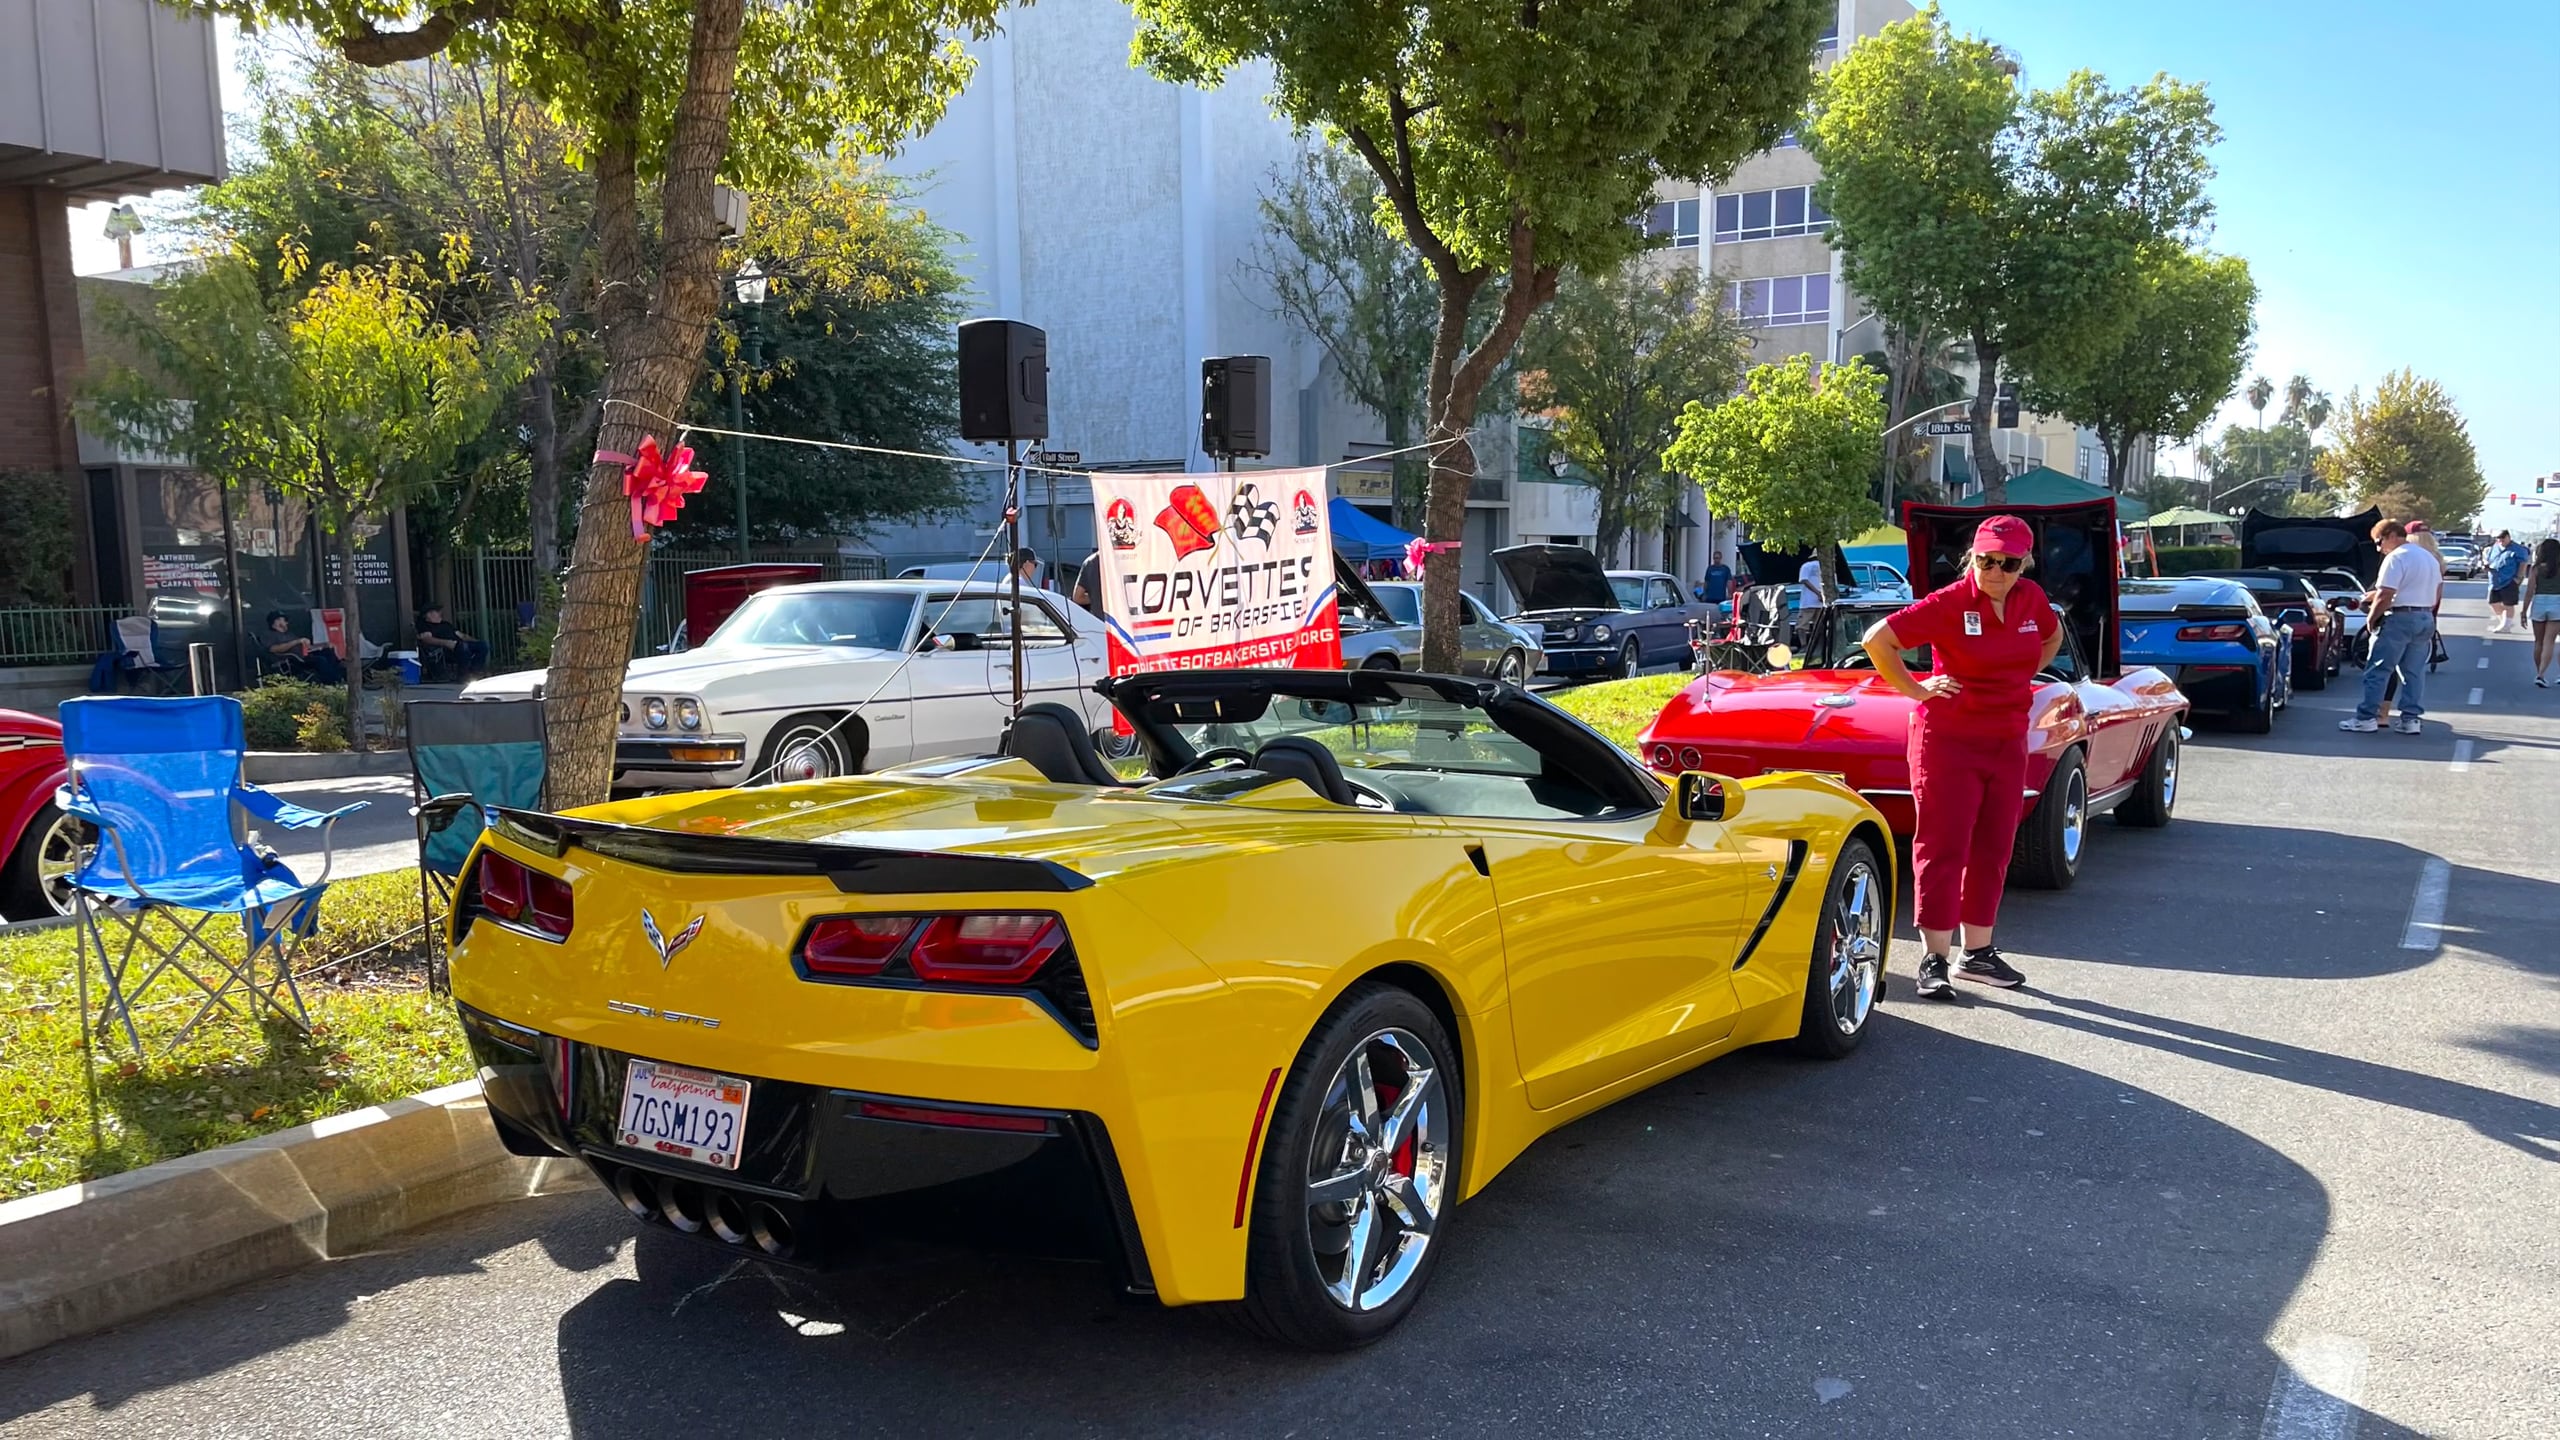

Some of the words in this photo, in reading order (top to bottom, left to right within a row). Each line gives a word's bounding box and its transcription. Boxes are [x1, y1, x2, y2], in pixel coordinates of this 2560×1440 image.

[1931, 423, 1950, 433] 18th
[1954, 423, 1971, 433] Str
[1057, 453, 1078, 462] Street
[161, 580, 192, 588] CARPAL
[1123, 556, 1313, 616] CORVETTES
[1177, 616, 1203, 637] OF
[1210, 600, 1306, 633] BAKERSFIE
[608, 1000, 721, 1029] CORVETTE
[651, 1076, 724, 1101] California
[632, 1094, 733, 1151] 7GSM193
